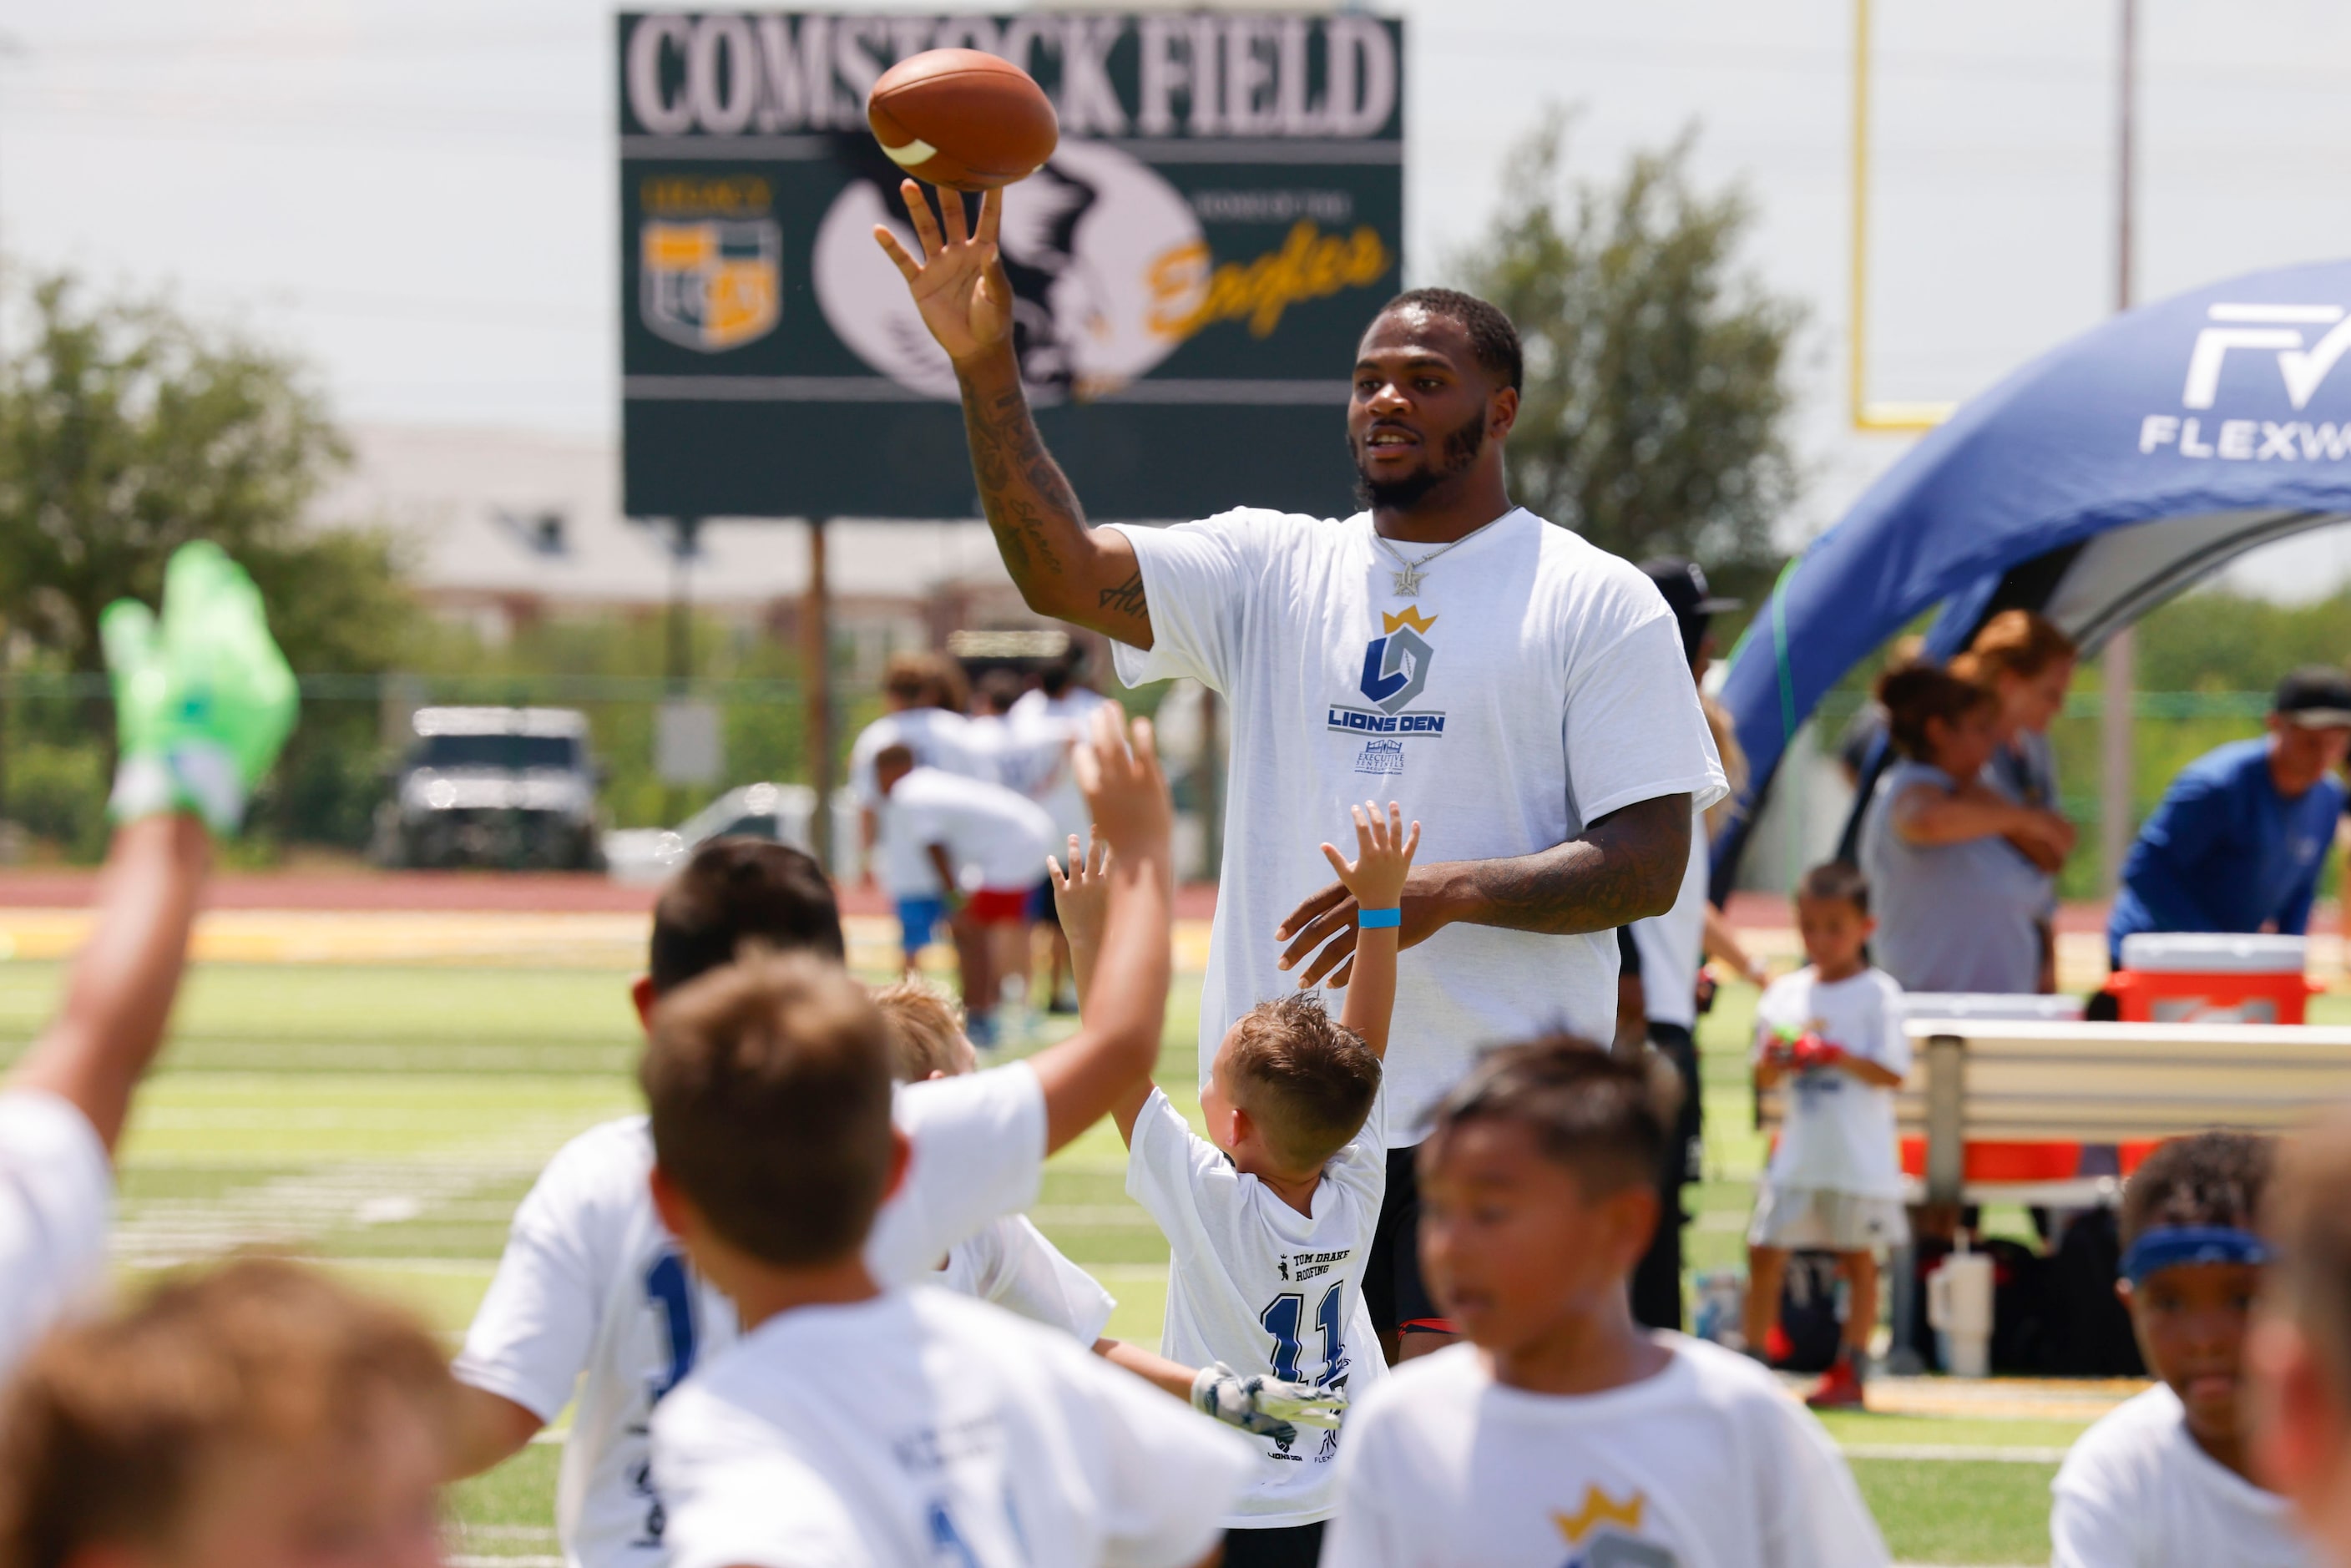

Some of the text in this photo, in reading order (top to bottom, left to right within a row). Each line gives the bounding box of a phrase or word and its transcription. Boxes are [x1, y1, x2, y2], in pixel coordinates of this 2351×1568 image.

[628, 17, 1397, 136] COMSCK FIELD
[1145, 222, 1389, 339] Eagles
[1328, 710, 1445, 731] LIONS DEN
[1358, 753, 1404, 761] EXECUTIVE
[1293, 1250, 1350, 1266] TOM DRAKE
[1296, 1265, 1329, 1282] ROOFING
[1261, 1280, 1343, 1388] 11
